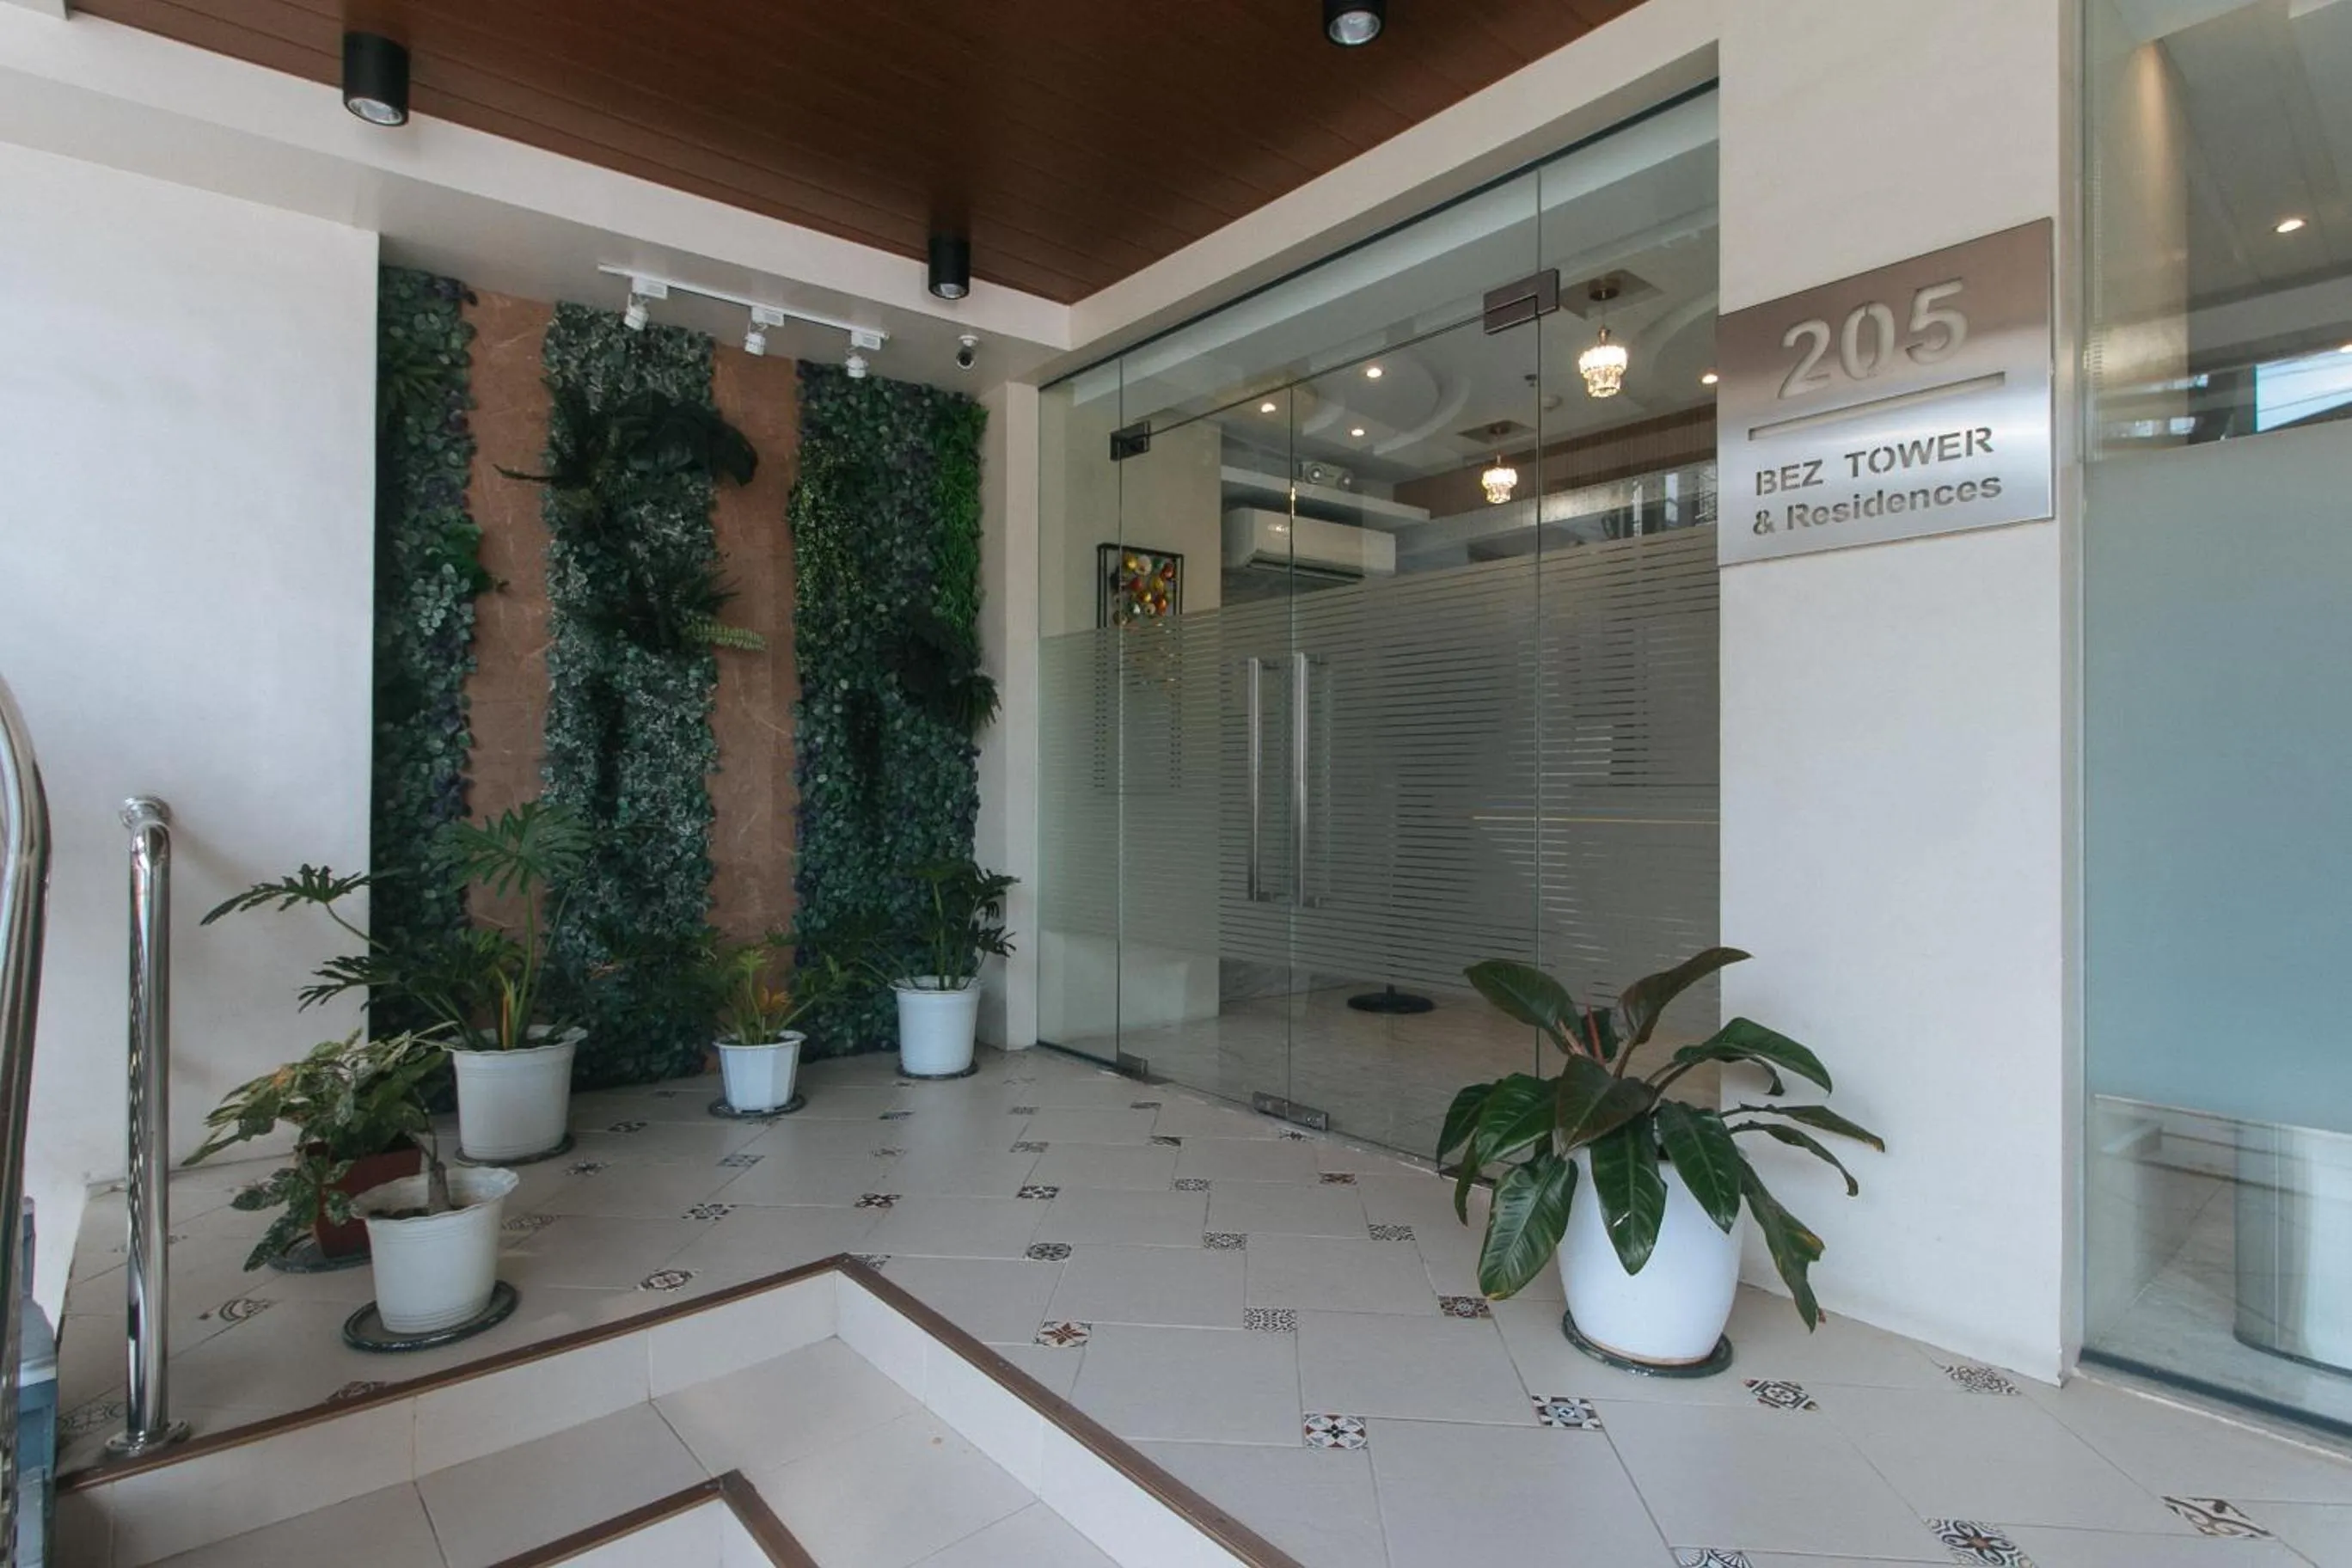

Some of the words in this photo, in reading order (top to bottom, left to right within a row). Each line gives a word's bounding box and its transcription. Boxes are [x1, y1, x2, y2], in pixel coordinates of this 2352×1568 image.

[1778, 278, 1967, 399] 205
[1756, 459, 1823, 496] BEZ
[1845, 427, 1994, 477] TOWER
[1754, 510, 1775, 535] &
[1787, 477, 2002, 530] Residences
